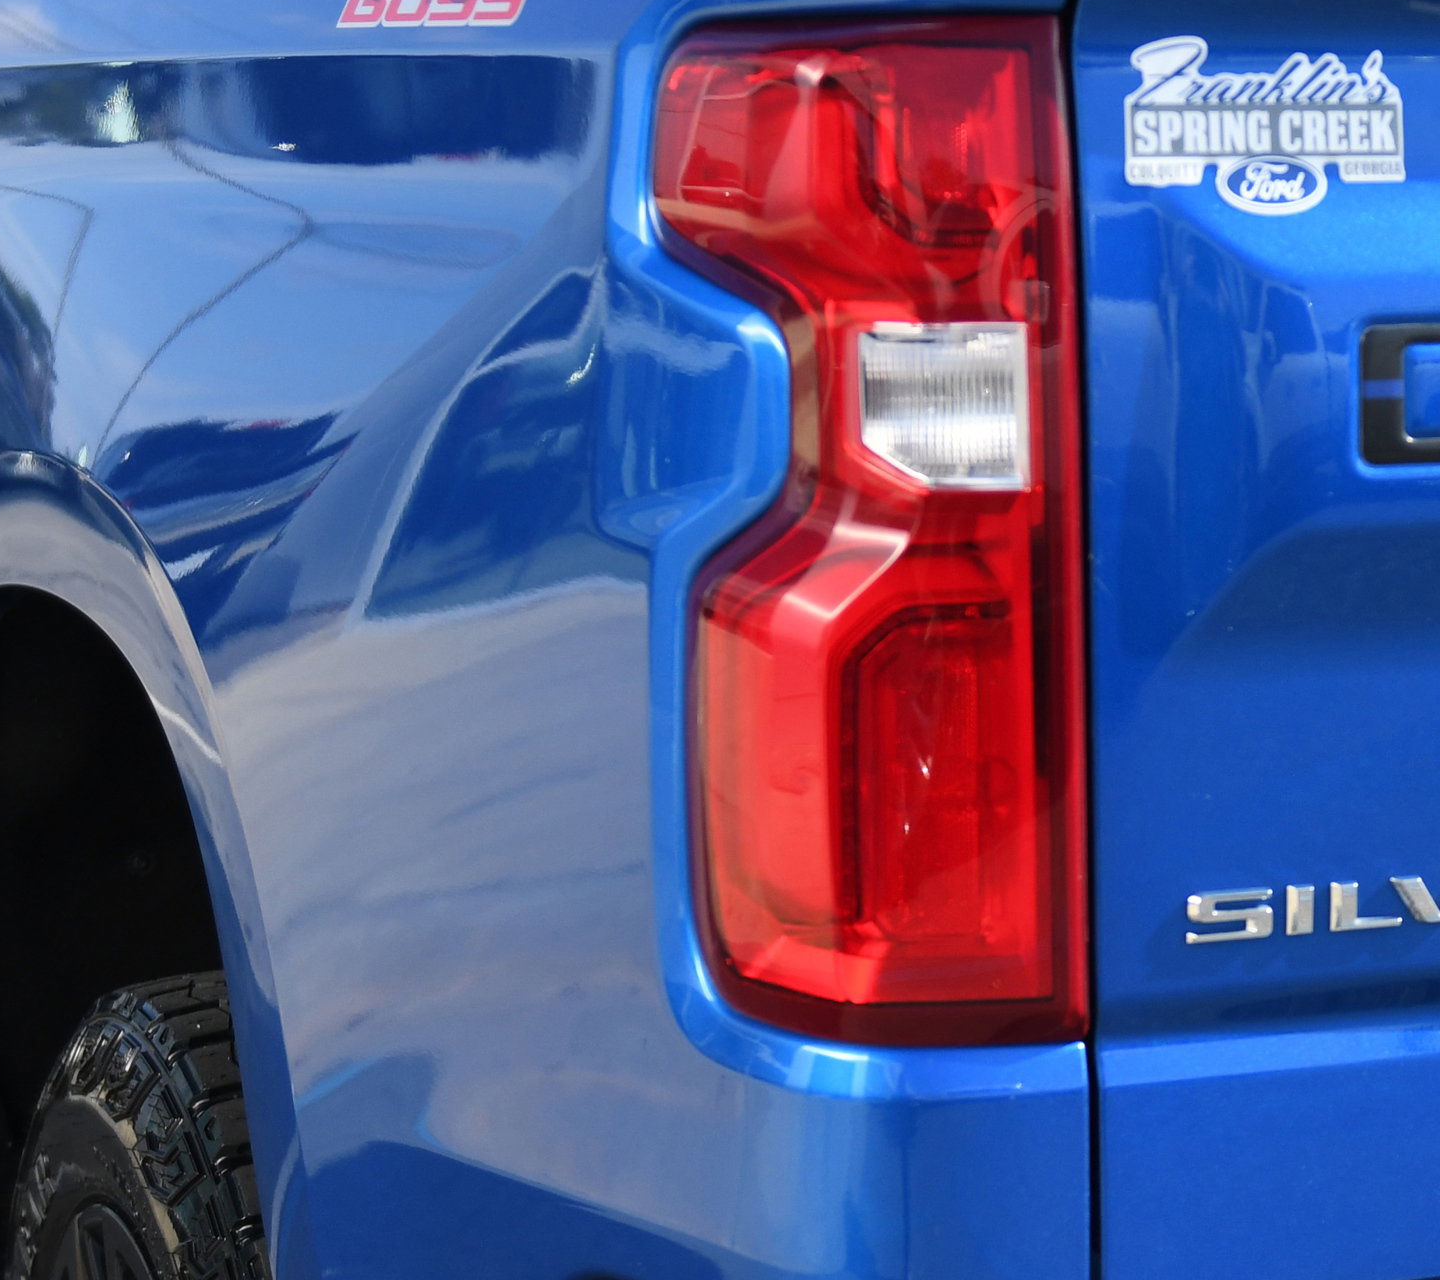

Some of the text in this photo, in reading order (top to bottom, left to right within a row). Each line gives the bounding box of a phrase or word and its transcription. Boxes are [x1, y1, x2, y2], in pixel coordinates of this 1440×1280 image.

[1130, 36, 1394, 106] Franklin's
[1133, 109, 1396, 154] SPRING CREEK
[1239, 161, 1308, 202] Ford
[1343, 160, 1402, 176] GEORGIA
